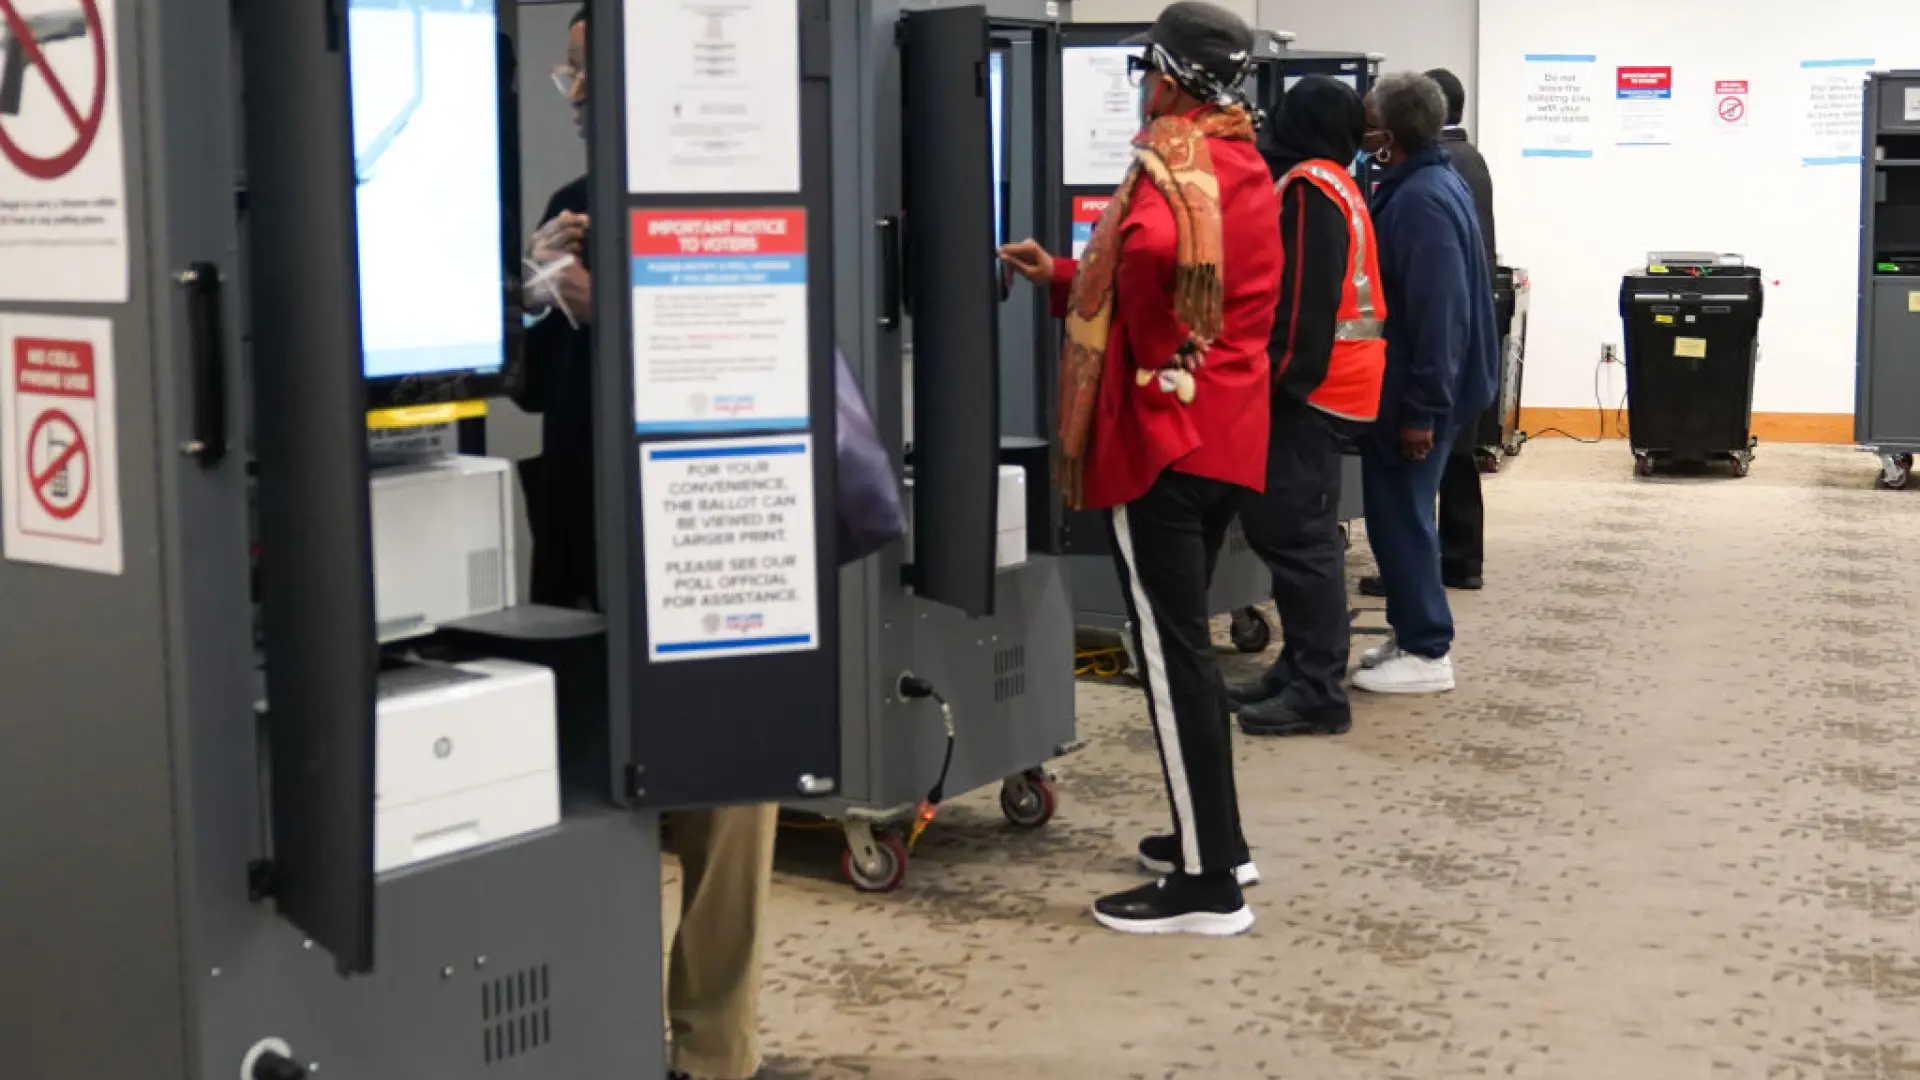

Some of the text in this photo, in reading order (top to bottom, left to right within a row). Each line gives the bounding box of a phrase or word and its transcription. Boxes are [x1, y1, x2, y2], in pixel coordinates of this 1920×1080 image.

[648, 217, 787, 236] IMPORTANT NOTICE
[678, 236, 759, 253] TO VOTERS
[687, 461, 769, 475] FOR YOUR
[668, 478, 788, 496] CONVENIENCE,
[662, 495, 796, 513] THE BALLOT CAN
[676, 512, 784, 530] BE VIEWED IN
[672, 529, 787, 547] LARGER PRINT.
[665, 554, 796, 574] PLEASE SEE OUR
[674, 573, 788, 591] POLL OFFICIAL
[661, 589, 801, 609] FOR ASSISTANCE.
